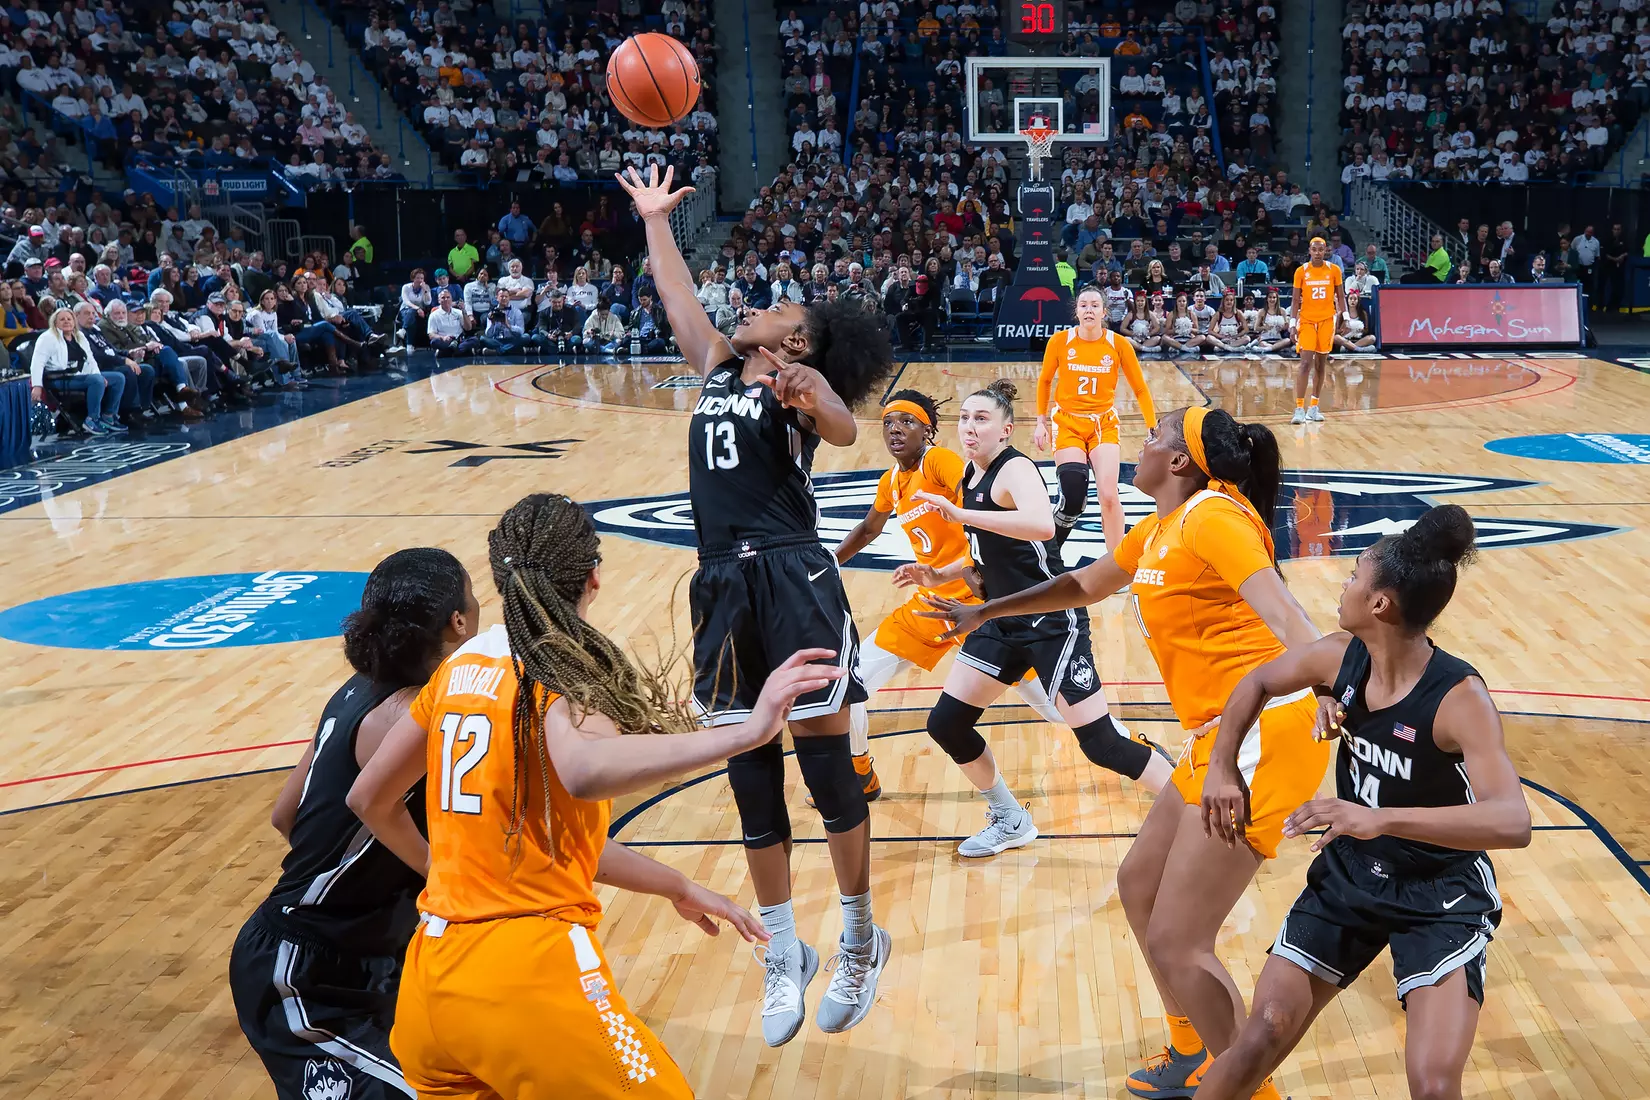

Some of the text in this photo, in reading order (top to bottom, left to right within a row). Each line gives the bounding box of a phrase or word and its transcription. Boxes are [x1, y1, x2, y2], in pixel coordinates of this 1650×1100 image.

[1021, 3, 1055, 33] 30
[223, 181, 242, 190] BUD
[242, 181, 266, 190] LIGHT
[1311, 286, 1326, 300] 25
[997, 324, 1077, 338] TRAVELE
[1408, 316, 1552, 340] Mohegan Sun
[1067, 363, 1112, 374] TENNESSEE
[1077, 376, 1098, 395] 21
[704, 420, 740, 470] 13
[964, 531, 986, 566] 4
[149, 569, 319, 648] genius3D
[439, 711, 493, 816] 12
[1340, 725, 1413, 781] CONN
